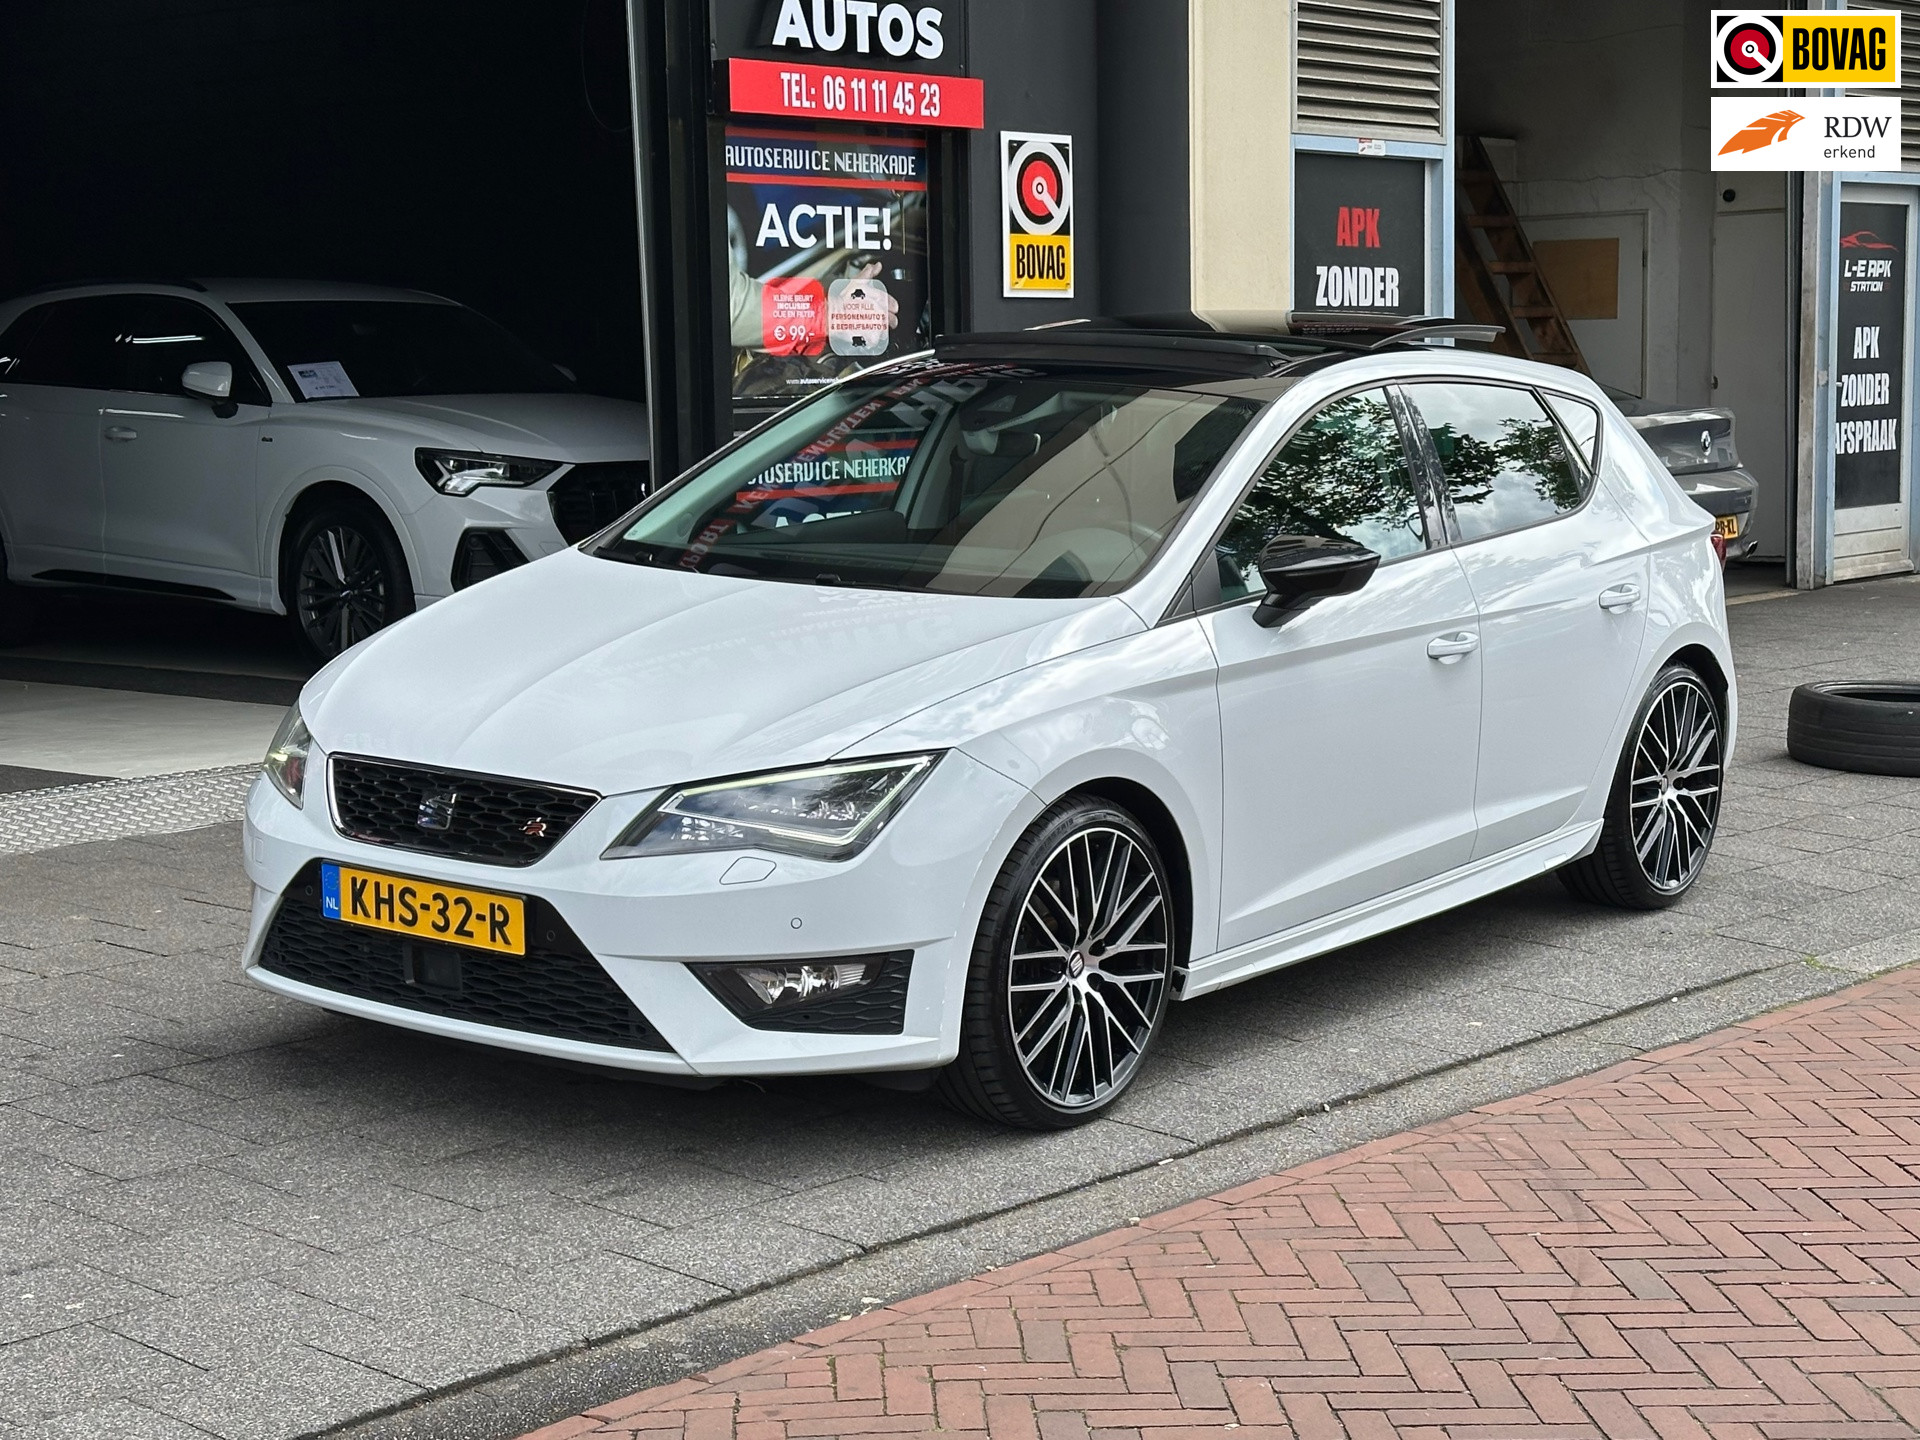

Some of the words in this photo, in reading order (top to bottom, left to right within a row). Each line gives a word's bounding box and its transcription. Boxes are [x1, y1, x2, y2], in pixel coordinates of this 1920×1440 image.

[772, 0, 944, 60] AUTOS
[780, 72, 816, 109] TEL:
[822, 75, 846, 111] 06
[851, 78, 867, 113] 11
[872, 80, 888, 114] 11
[892, 81, 915, 115] 45
[920, 83, 941, 118] 23
[725, 145, 830, 172] AUTOSERVICE
[834, 152, 917, 176] NEHERKADE
[755, 203, 893, 251] ACTIE!
[1336, 206, 1381, 248] APK
[1016, 244, 1066, 281] BOVAG
[1843, 259, 1867, 278] L-E
[1867, 259, 1892, 278] APK
[1315, 265, 1400, 307] ZONDER
[1849, 281, 1884, 292] STATION
[789, 325, 816, 344] 99,-
[1853, 326, 1880, 359] APK
[1840, 373, 1890, 407] ZONDER
[326, 896, 339, 910] NL
[351, 876, 512, 946] KHS-32-R
